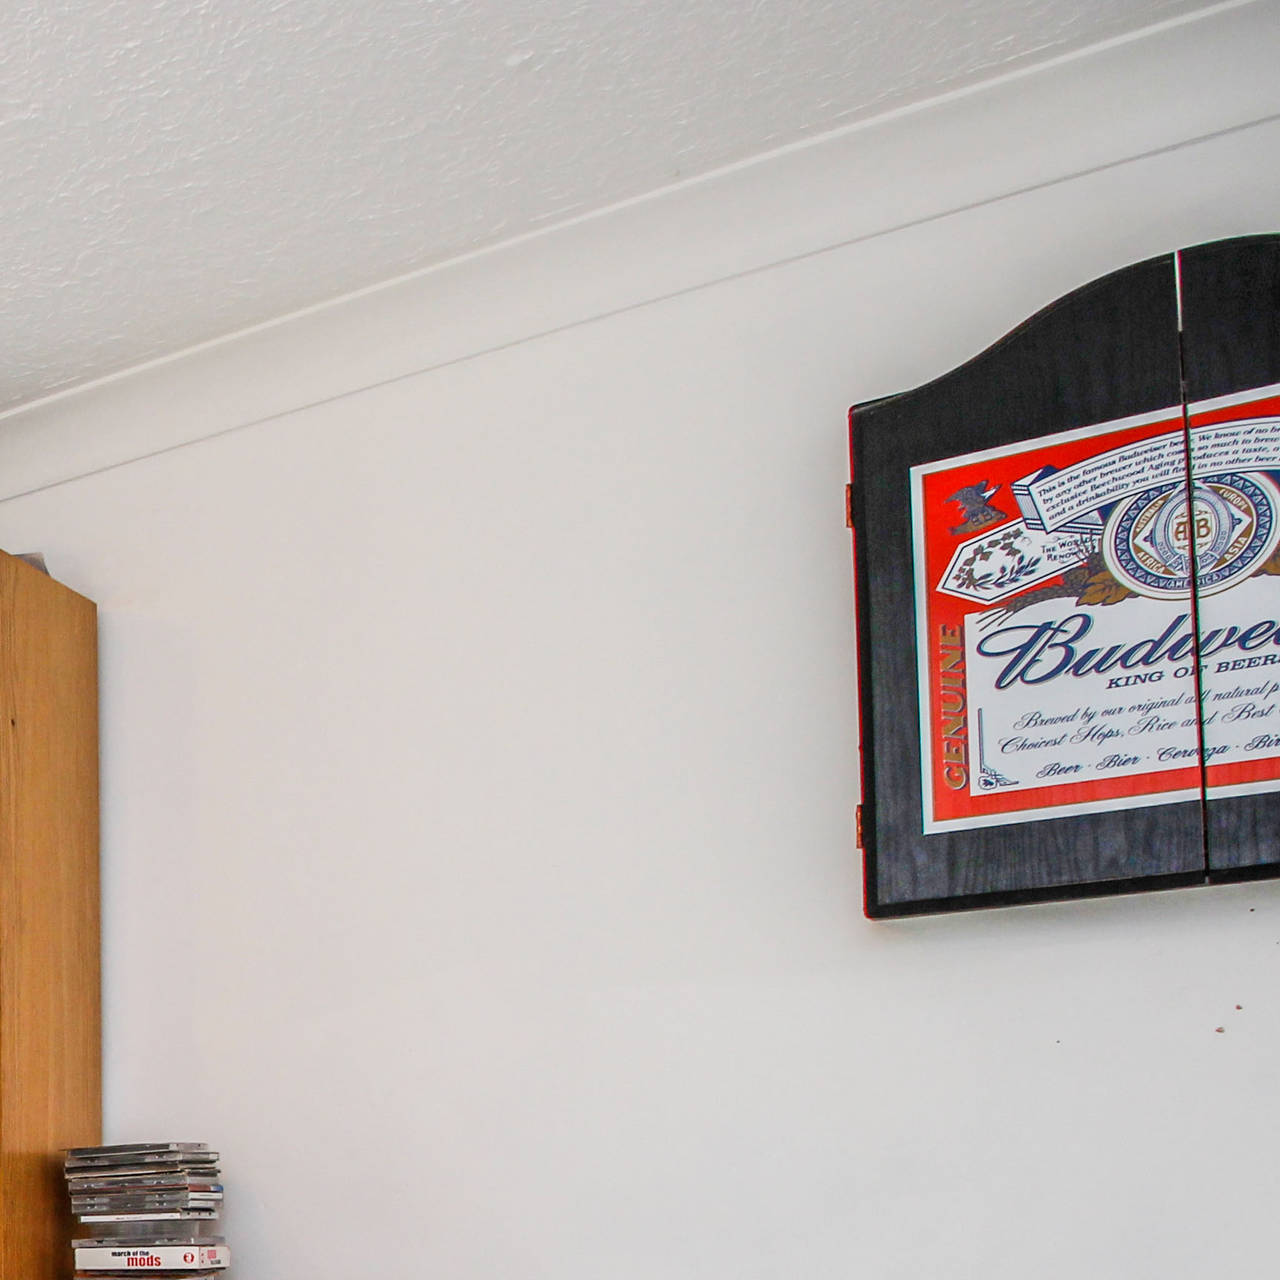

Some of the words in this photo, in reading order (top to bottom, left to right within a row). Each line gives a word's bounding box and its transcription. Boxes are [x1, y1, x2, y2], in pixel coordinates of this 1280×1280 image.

[1055, 488, 1072, 499] any
[1072, 475, 1098, 490] other
[1099, 462, 1133, 478] brewer
[1134, 452, 1165, 466] which
[1210, 439, 1240, 449] much
[1067, 473, 1081, 483] the
[1081, 459, 1117, 477] famous
[1118, 444, 1168, 463] Budweiser
[1089, 467, 1145, 492] Beechwood
[1147, 458, 1177, 473] Aging
[1178, 450, 1230, 465] poduces
[1131, 475, 1150, 489] you
[1151, 467, 1171, 481] will
[1224, 456, 1253, 466] other
[1219, 488, 1249, 511] EUROPE
[1136, 551, 1166, 574] AFRICA
[1223, 536, 1248, 561] ASIA
[1105, 670, 1165, 690] KING
[940, 623, 969, 791] GENUINE
[1012, 710, 1077, 730] Brewed
[1079, 706, 1098, 723] by
[1100, 705, 1124, 717] our
[1127, 690, 1186, 715] original
[1212, 679, 1266, 701] natural
[998, 732, 1068, 756] Choicest
[1127, 714, 1178, 736] Rice
[1221, 702, 1276, 724] Best
[1035, 761, 1085, 779] Beer
[1095, 749, 1142, 770] Bier
[127, 1254, 162, 1267] mods
